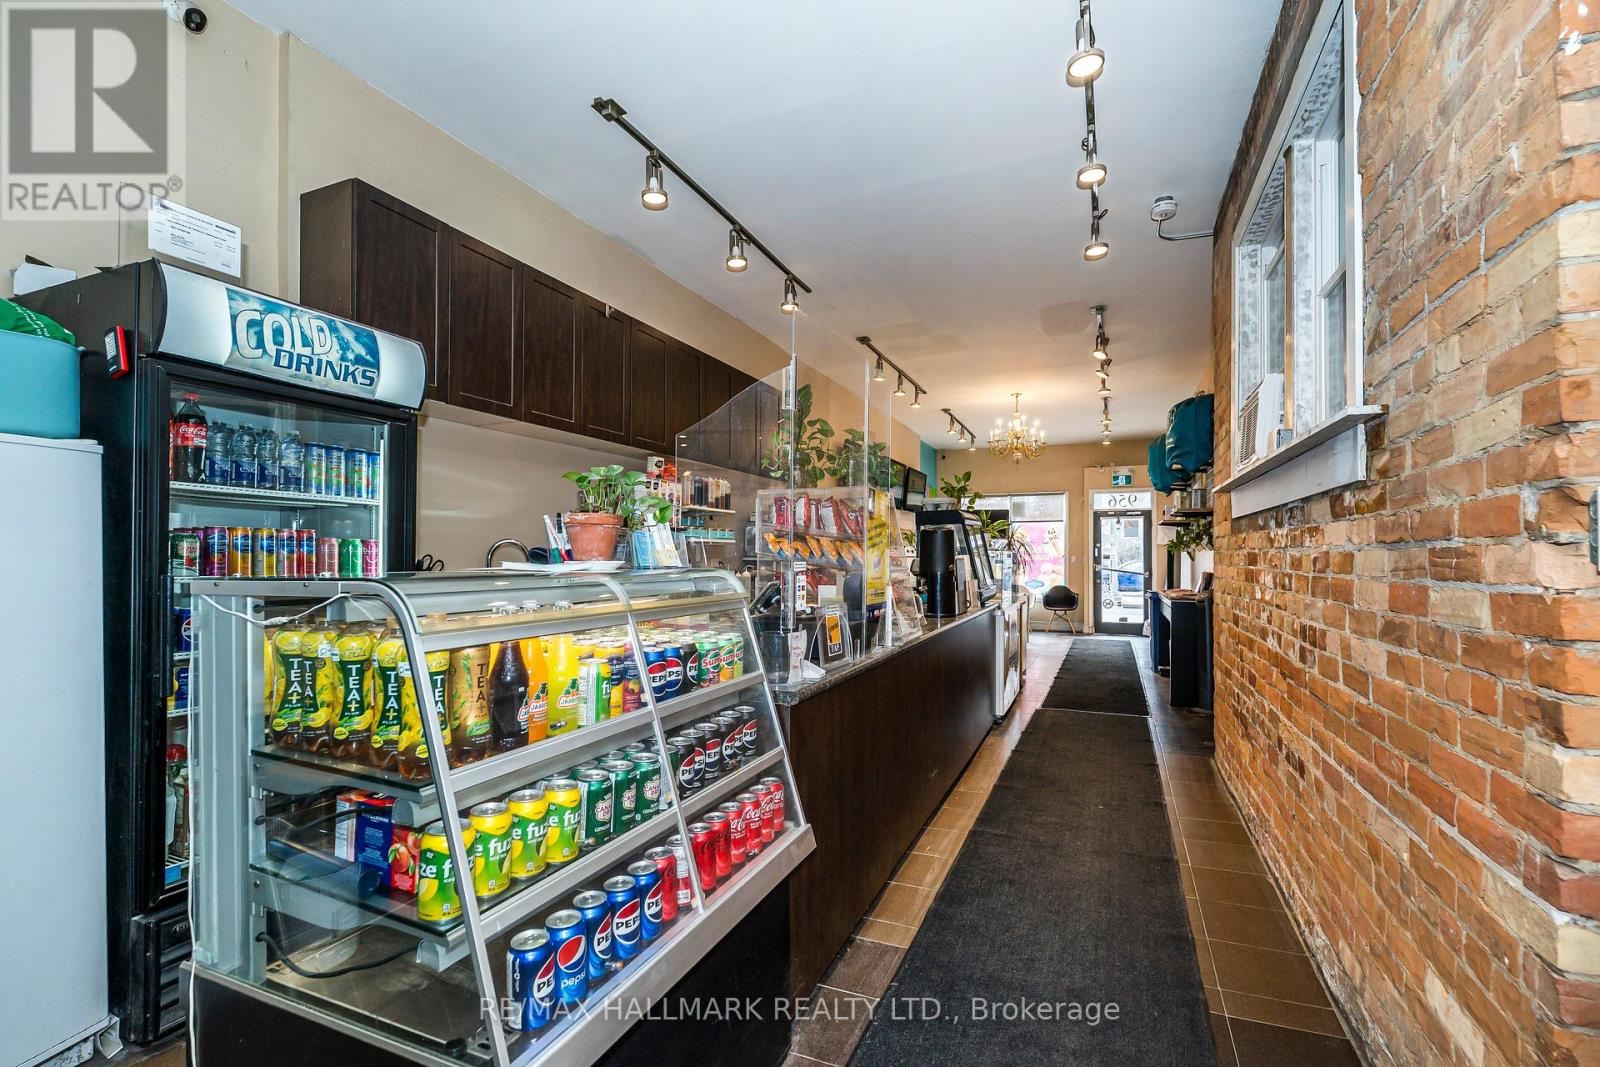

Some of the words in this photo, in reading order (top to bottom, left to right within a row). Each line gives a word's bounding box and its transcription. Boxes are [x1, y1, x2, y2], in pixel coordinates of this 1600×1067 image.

[235, 309, 333, 360] COLD
[272, 347, 377, 388] DRINKS
[420, 863, 437, 878] ze
[561, 968, 586, 990] pepsi
